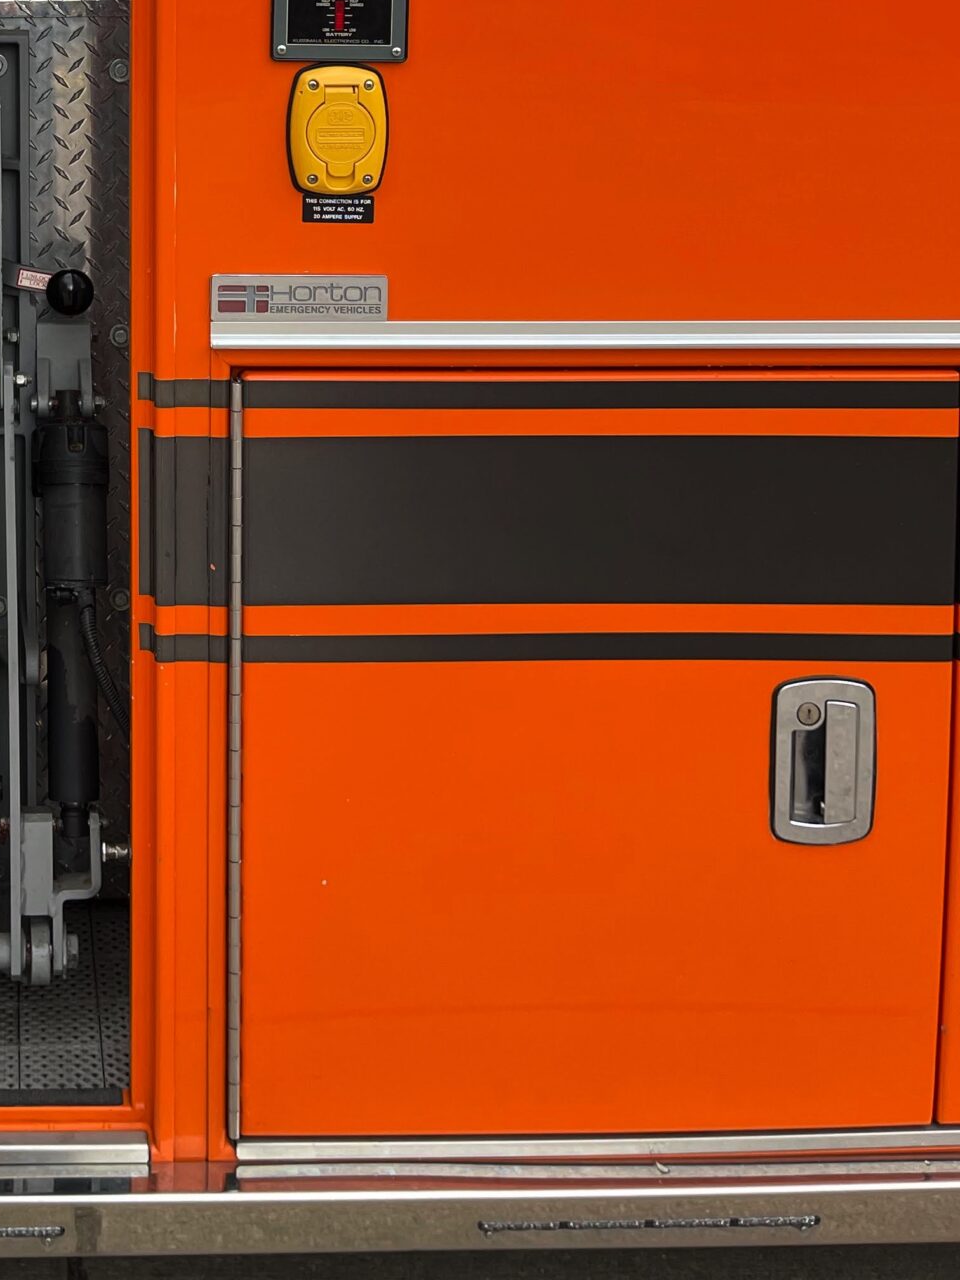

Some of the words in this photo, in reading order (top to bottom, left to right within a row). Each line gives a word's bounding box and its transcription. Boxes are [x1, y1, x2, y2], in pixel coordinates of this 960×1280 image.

[270, 283, 382, 302] Horton
[270, 305, 330, 314] EMERGENCY
[334, 305, 382, 314] VEHICLES
